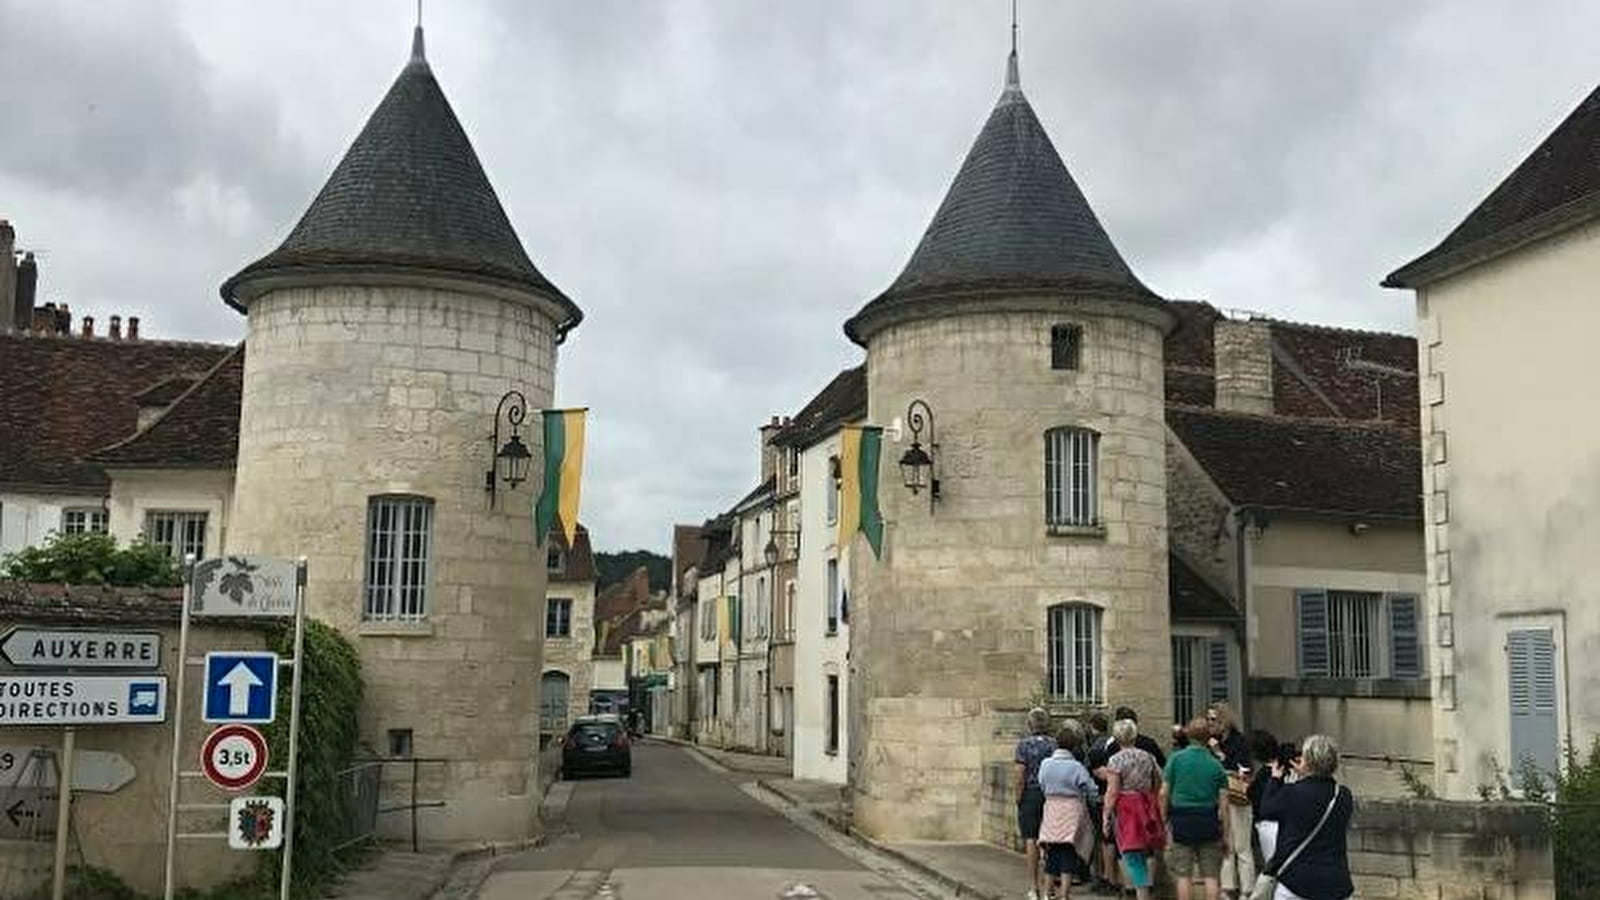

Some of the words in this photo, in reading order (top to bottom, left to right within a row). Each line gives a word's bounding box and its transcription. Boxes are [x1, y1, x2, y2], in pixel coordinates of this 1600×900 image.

[32, 638, 152, 661] AUXERRE
[0, 681, 74, 698] TOUTES
[219, 748, 251, 767] 3,5t
